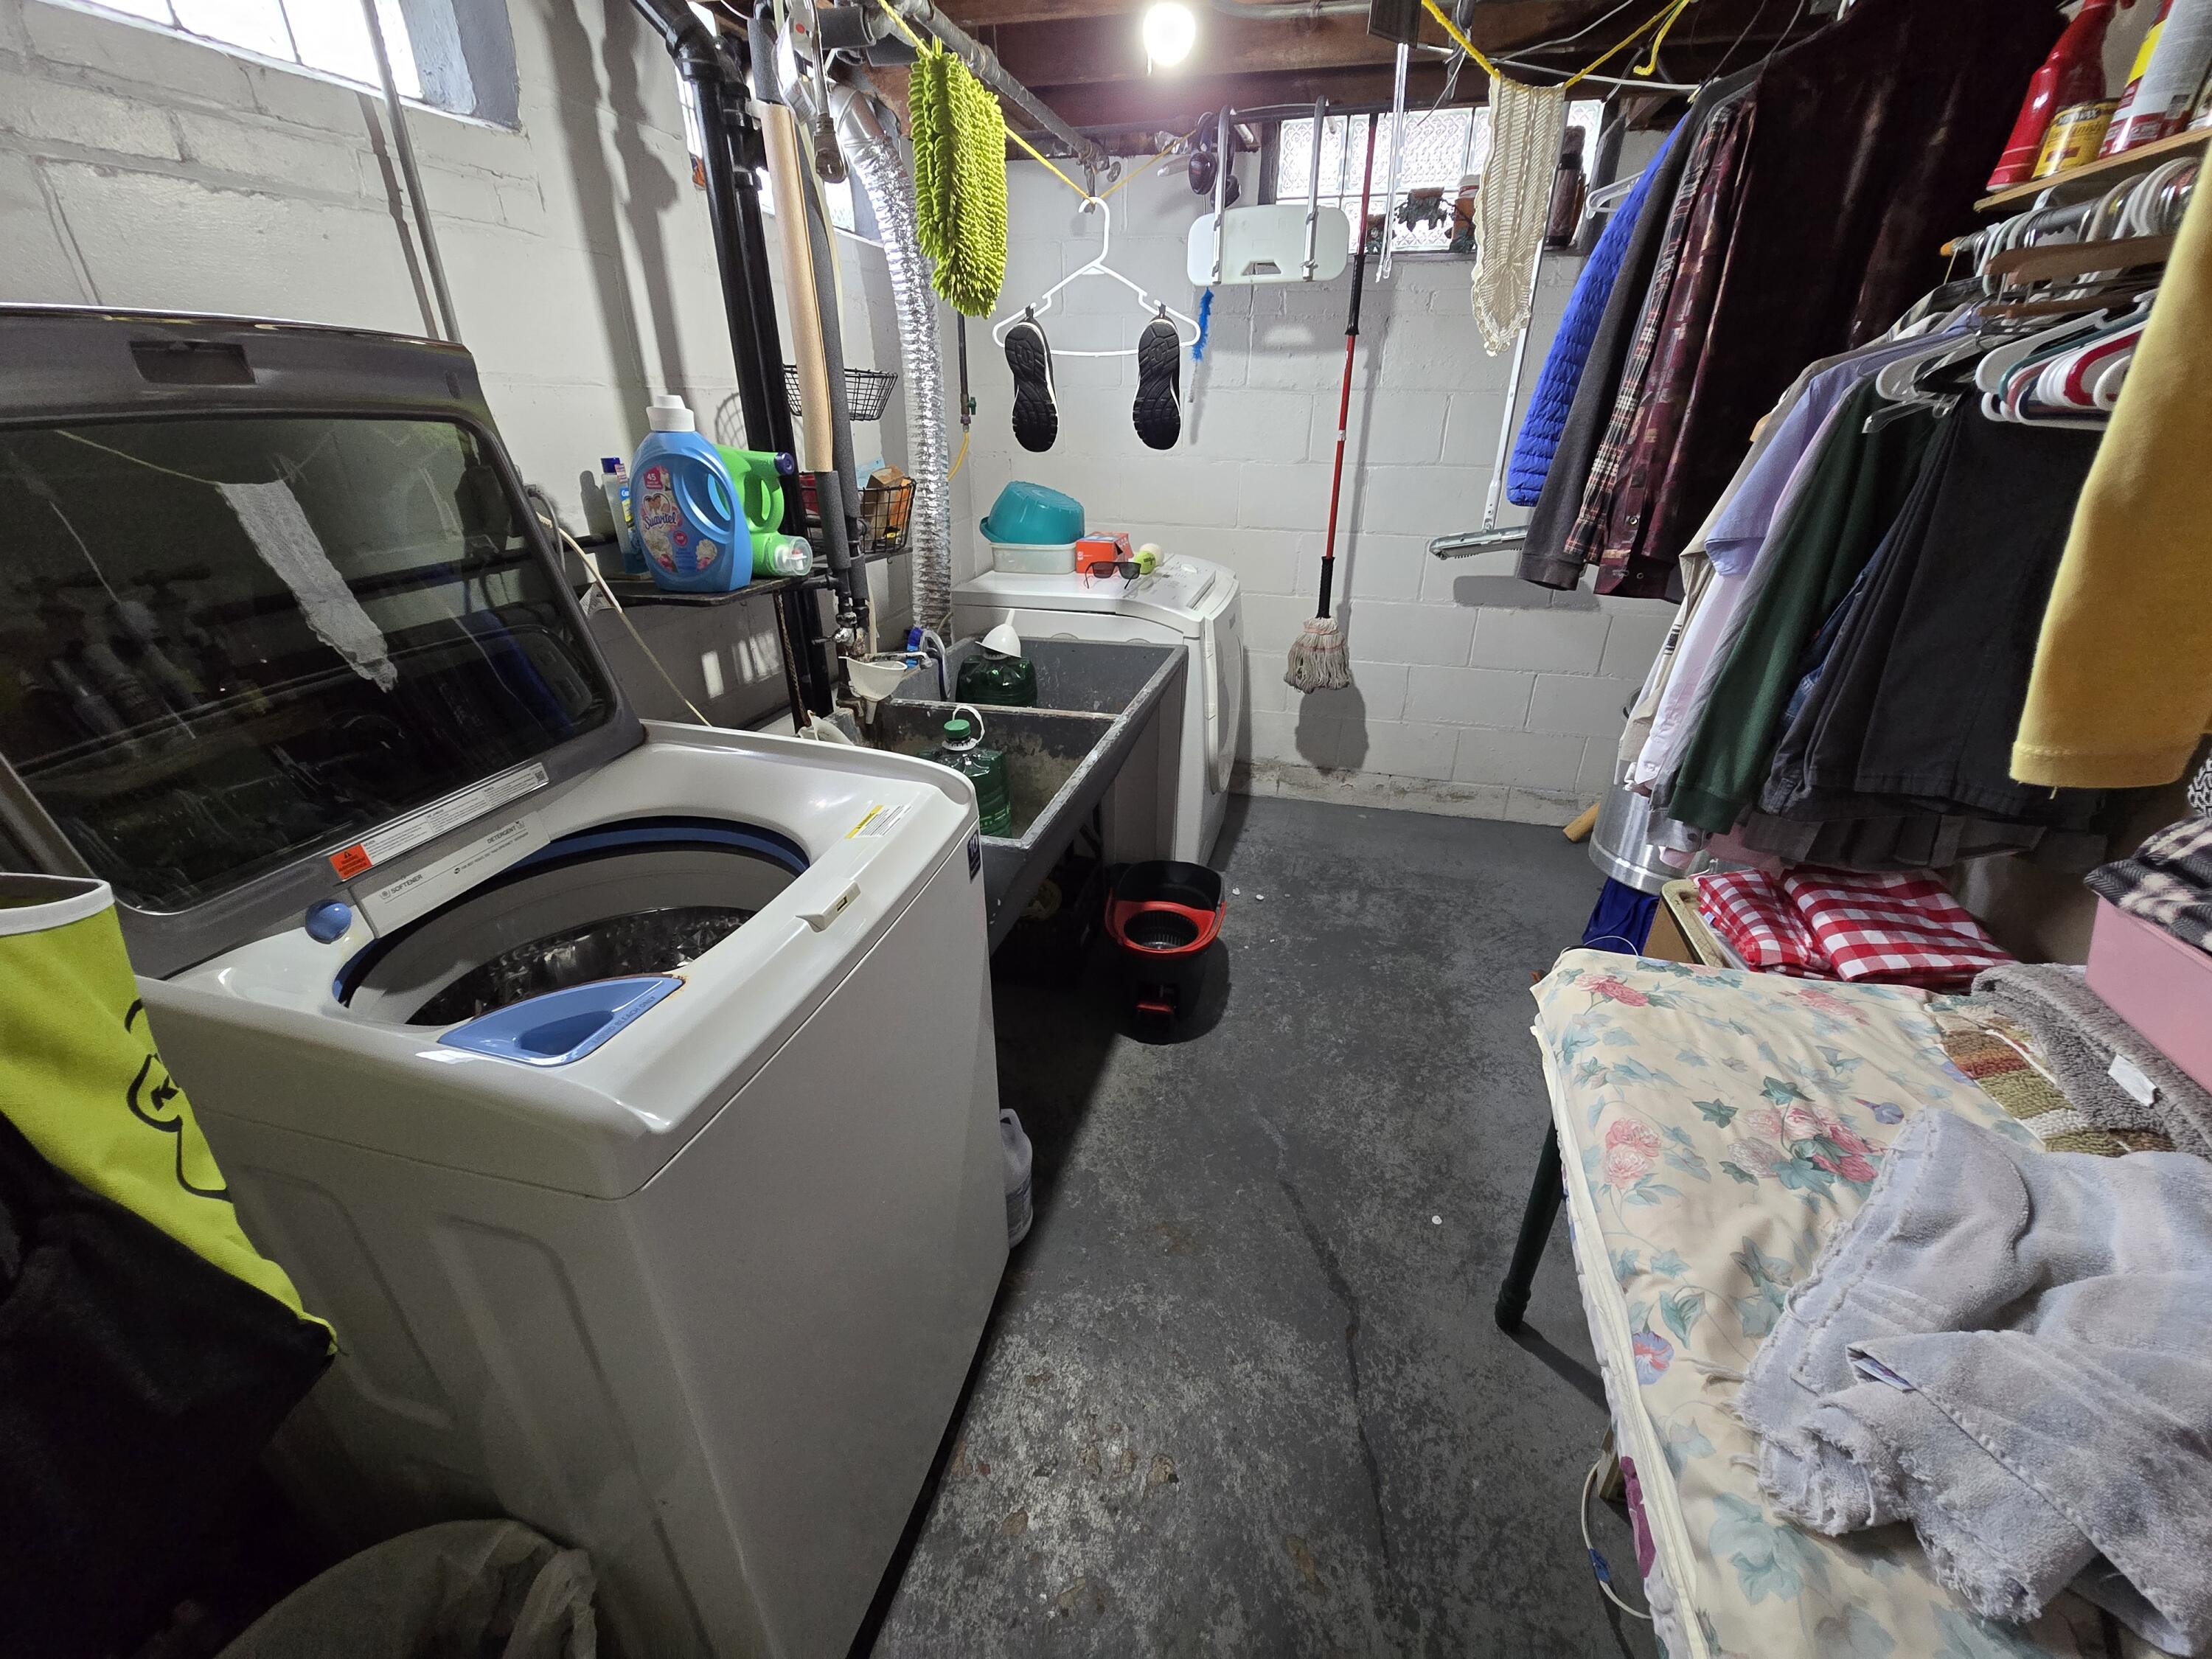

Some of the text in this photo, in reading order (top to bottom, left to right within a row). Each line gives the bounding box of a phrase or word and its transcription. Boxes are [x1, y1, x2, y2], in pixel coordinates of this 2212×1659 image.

[647, 473, 656, 481] 45
[644, 512, 677, 530] Suavitel
[487, 825, 516, 844] DETERGENT
[391, 874, 423, 894] SOFTENER
[614, 1008, 640, 1026] BLEACH
[639, 995, 655, 1008] ONLY
